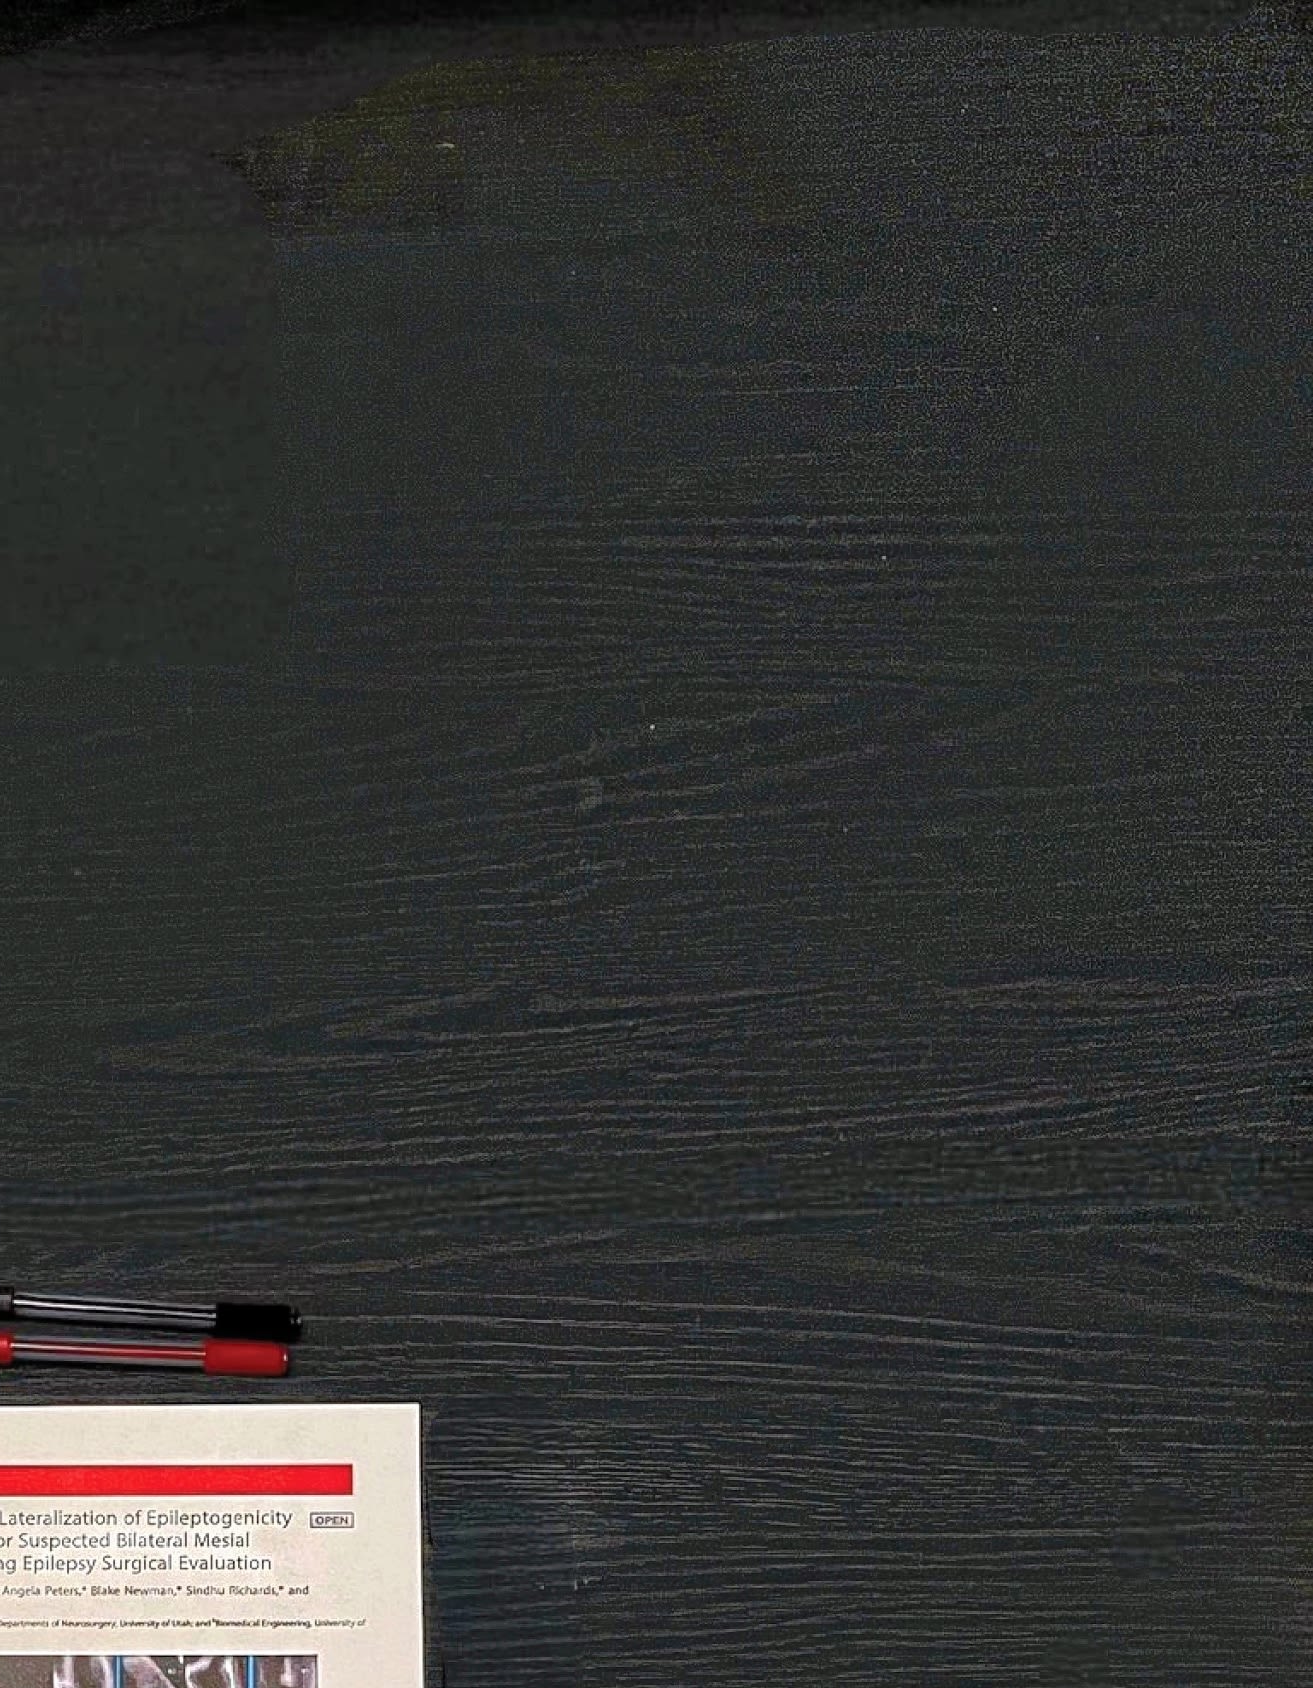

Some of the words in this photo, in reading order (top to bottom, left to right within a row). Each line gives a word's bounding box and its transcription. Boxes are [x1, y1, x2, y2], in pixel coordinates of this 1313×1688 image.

[0, 1510, 117, 1525] Lateralization
[124, 1510, 142, 1525] of
[147, 1510, 293, 1529] Epileptogenicity
[315, 1516, 348, 1525] OPEN
[19, 1533, 110, 1552] Suspected
[117, 1531, 187, 1548] Bilateral
[194, 1532, 249, 1548] Mesial
[23, 1555, 96, 1575] Epilepsy
[101, 1554, 172, 1574] Surgical
[180, 1554, 271, 1570] Evaluation
